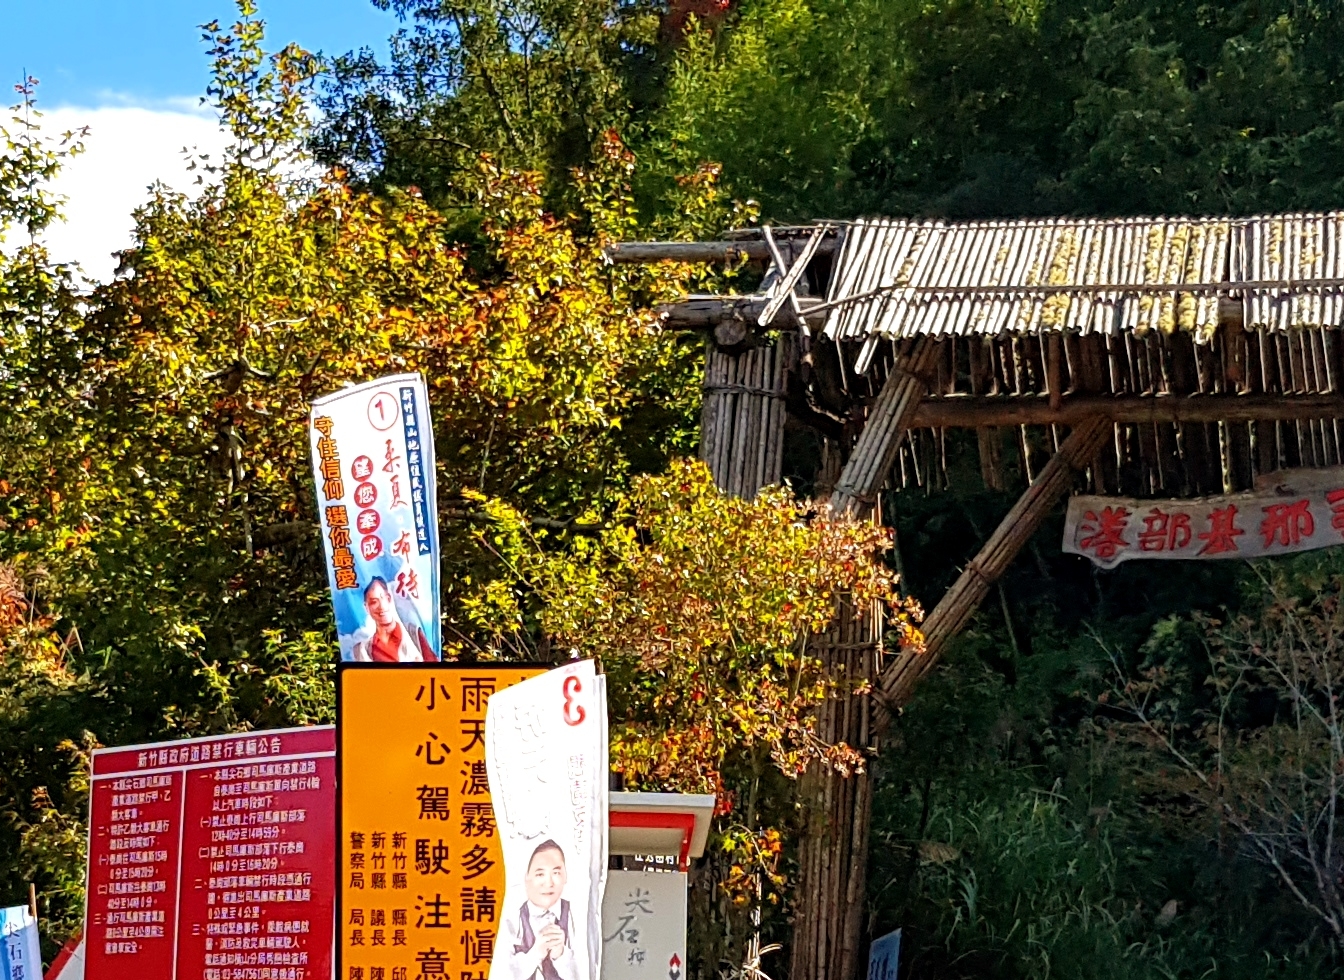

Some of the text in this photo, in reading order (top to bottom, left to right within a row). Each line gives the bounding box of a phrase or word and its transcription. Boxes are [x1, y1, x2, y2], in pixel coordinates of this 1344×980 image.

[314, 416, 359, 589] 守住信仰 選你最愛
[349, 831, 367, 890] 警察局
[370, 831, 388, 890] 新竹縣
[391, 831, 409, 890] 新竹縣
[349, 908, 366, 947] 局長
[370, 908, 387, 947] 議長
[391, 908, 408, 947] 縣長
